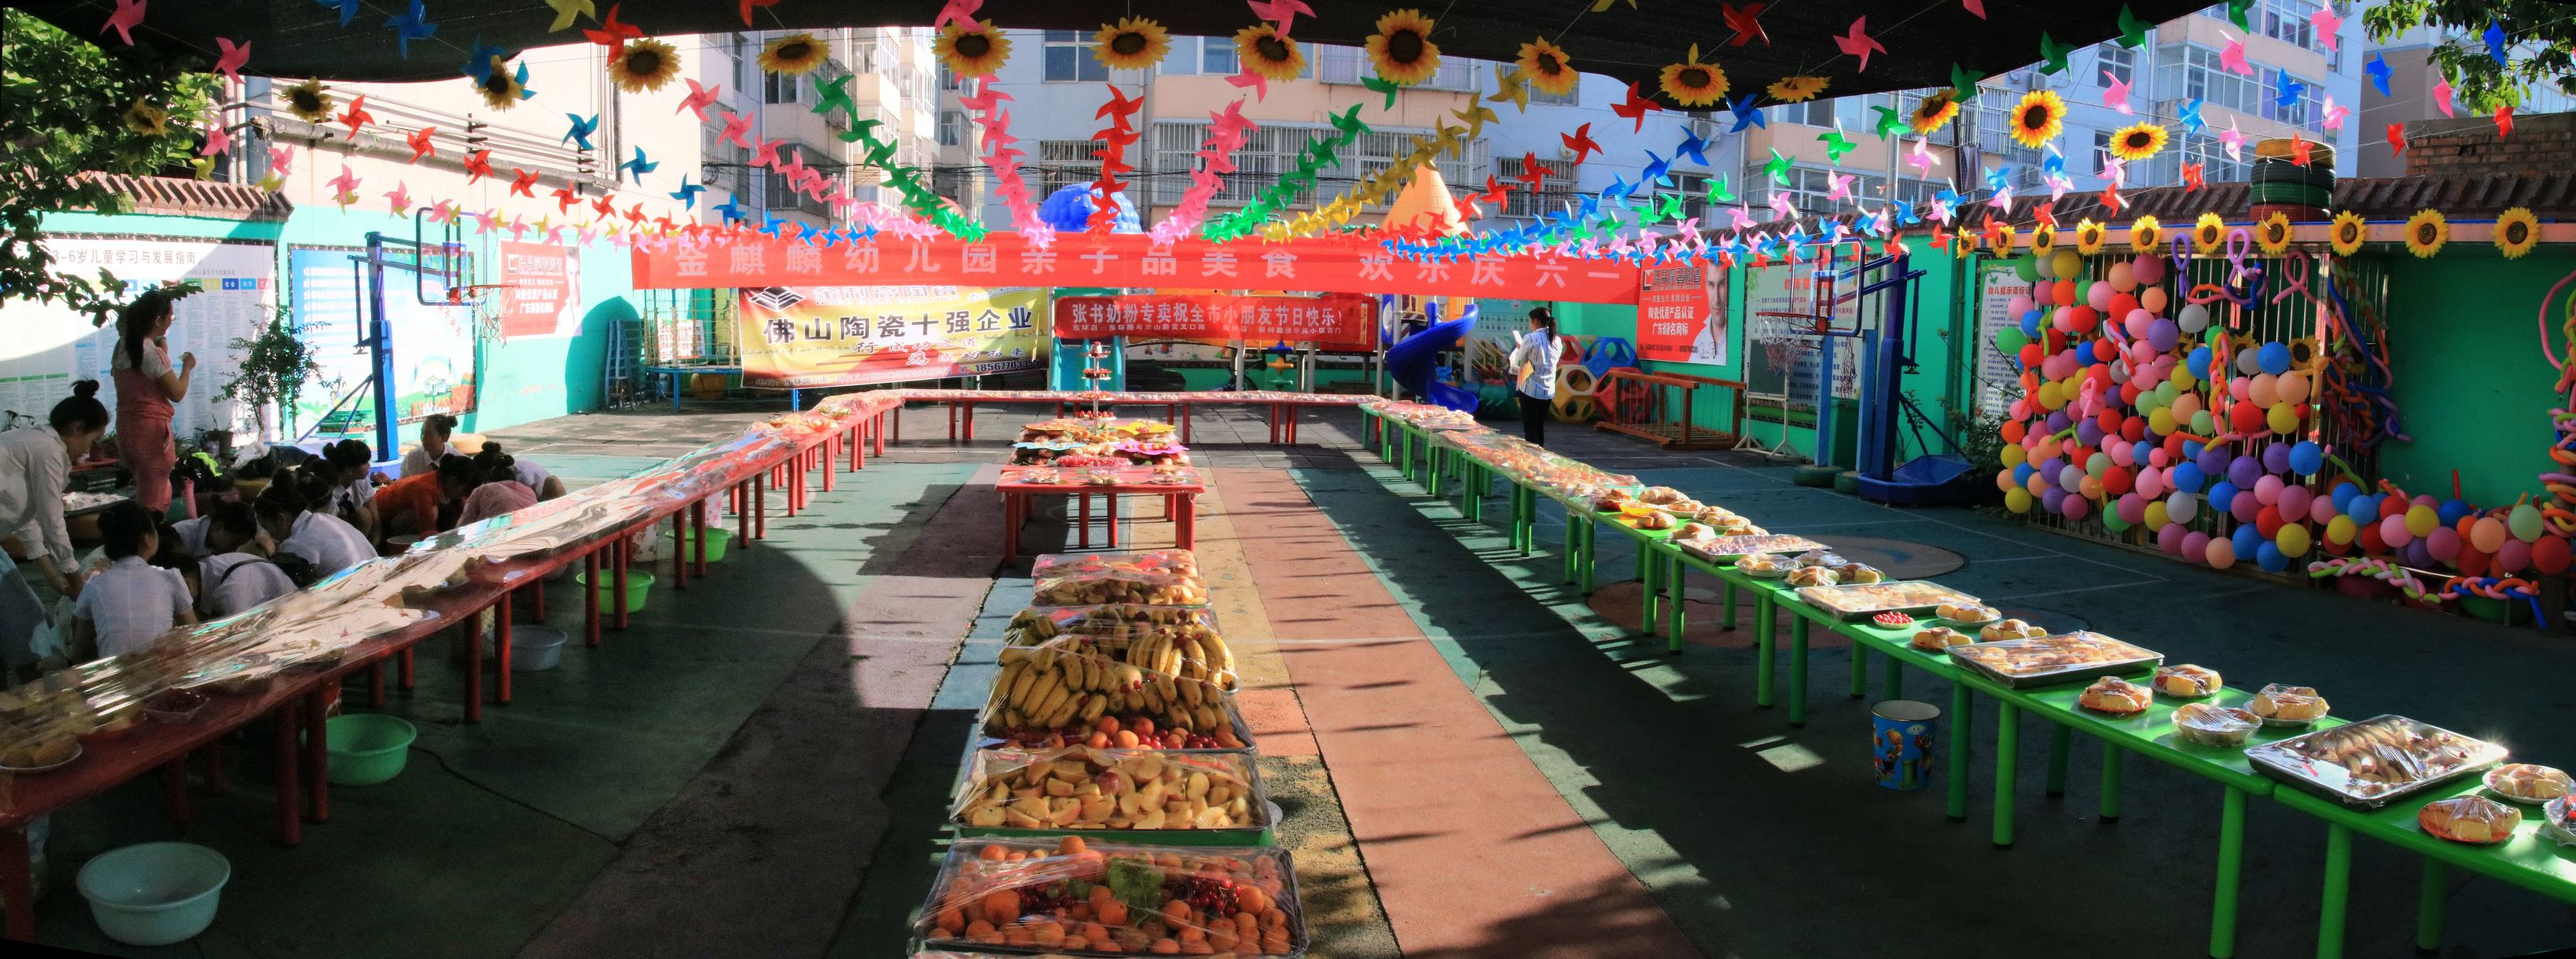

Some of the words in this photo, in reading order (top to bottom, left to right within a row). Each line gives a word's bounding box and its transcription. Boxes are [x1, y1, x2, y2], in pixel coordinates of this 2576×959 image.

[1648, 306, 1694, 319] 陶瓷优质产品认证
[763, 307, 1033, 344] 佛山陶瓷十强企业
